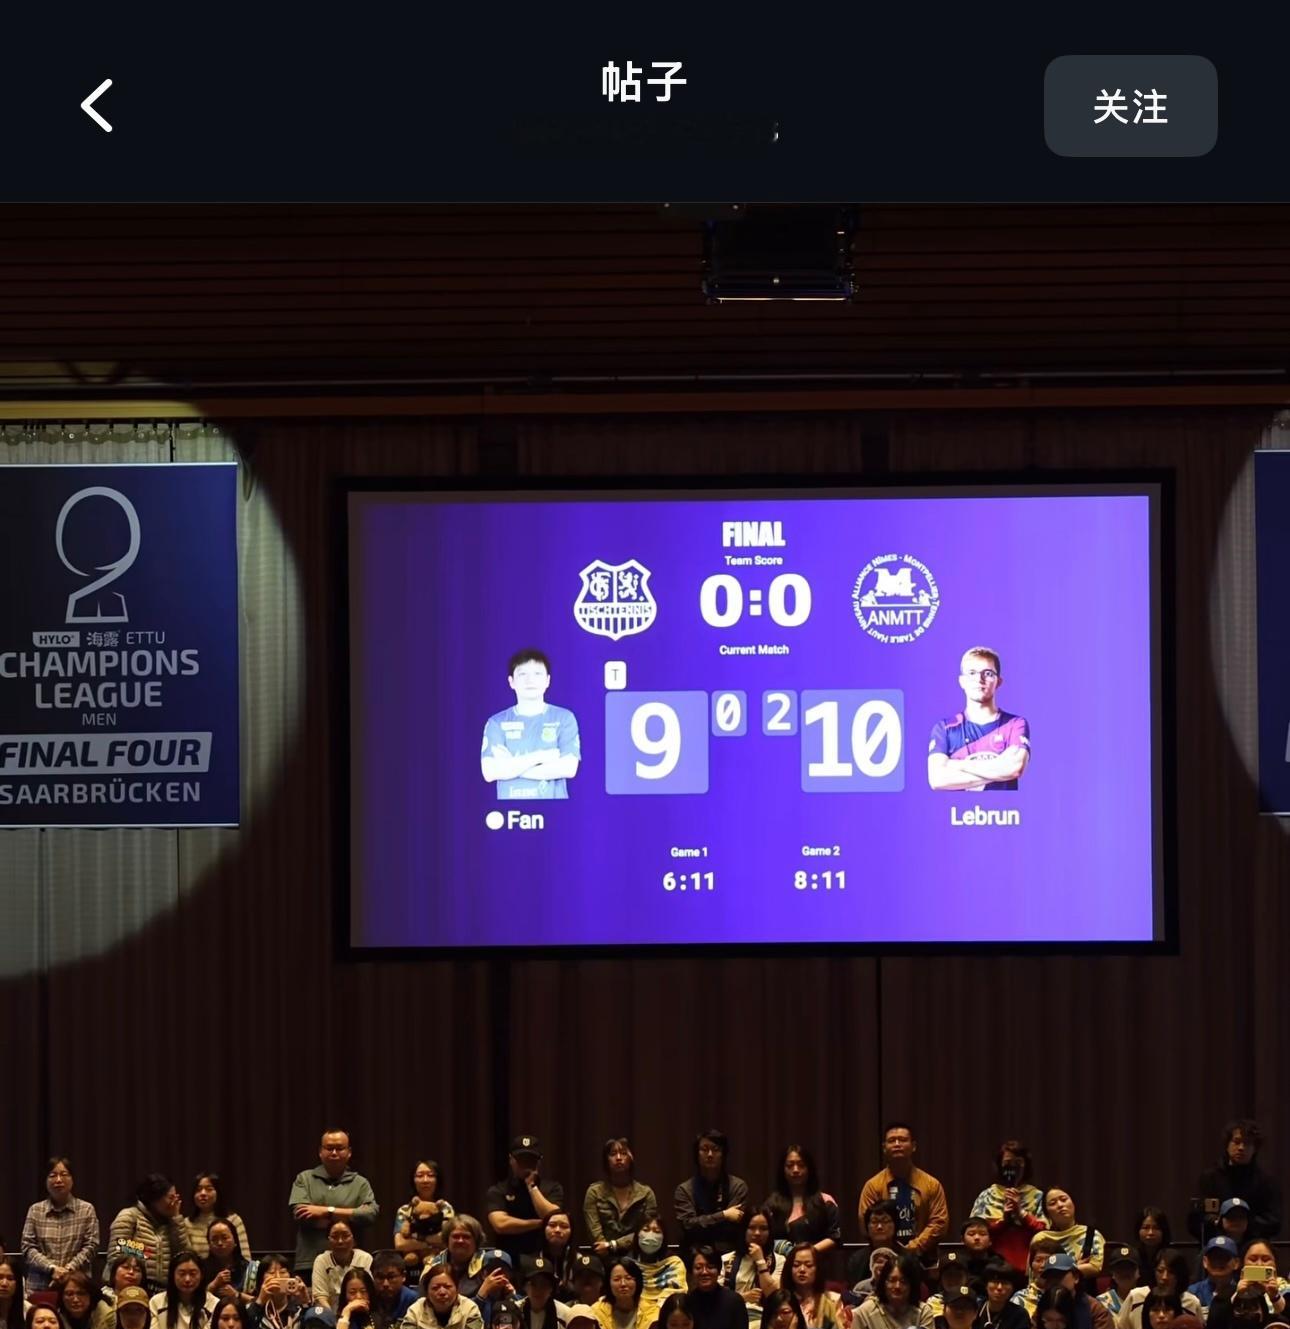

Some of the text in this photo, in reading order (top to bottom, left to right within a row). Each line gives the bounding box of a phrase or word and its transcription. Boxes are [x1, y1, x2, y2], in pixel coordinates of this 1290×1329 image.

[722, 521, 786, 547] FINAL
[725, 555, 783, 566] Team Score
[699, 572, 812, 628] 0:0
[868, 609, 925, 626] ANMTT
[39, 634, 72, 645] HYLO
[126, 631, 166, 645] ETTU
[719, 645, 790, 656] Current Match
[0, 650, 201, 678] CHAMPIONS
[35, 682, 163, 709] LEAGUE
[82, 713, 117, 726] MEN
[716, 693, 741, 731] 0
[767, 693, 791, 731] 2
[630, 702, 681, 780] 9
[805, 700, 902, 777] 10
[0, 739, 201, 768] FINAL FOUR
[0, 778, 200, 805] SAARBRÜCKEN
[507, 811, 544, 829] Fan
[951, 805, 1020, 826] Lebrun
[670, 847, 708, 858] Game 1
[802, 846, 841, 857] Game 2
[663, 872, 714, 891] 6:11
[794, 871, 846, 890] 8:11
